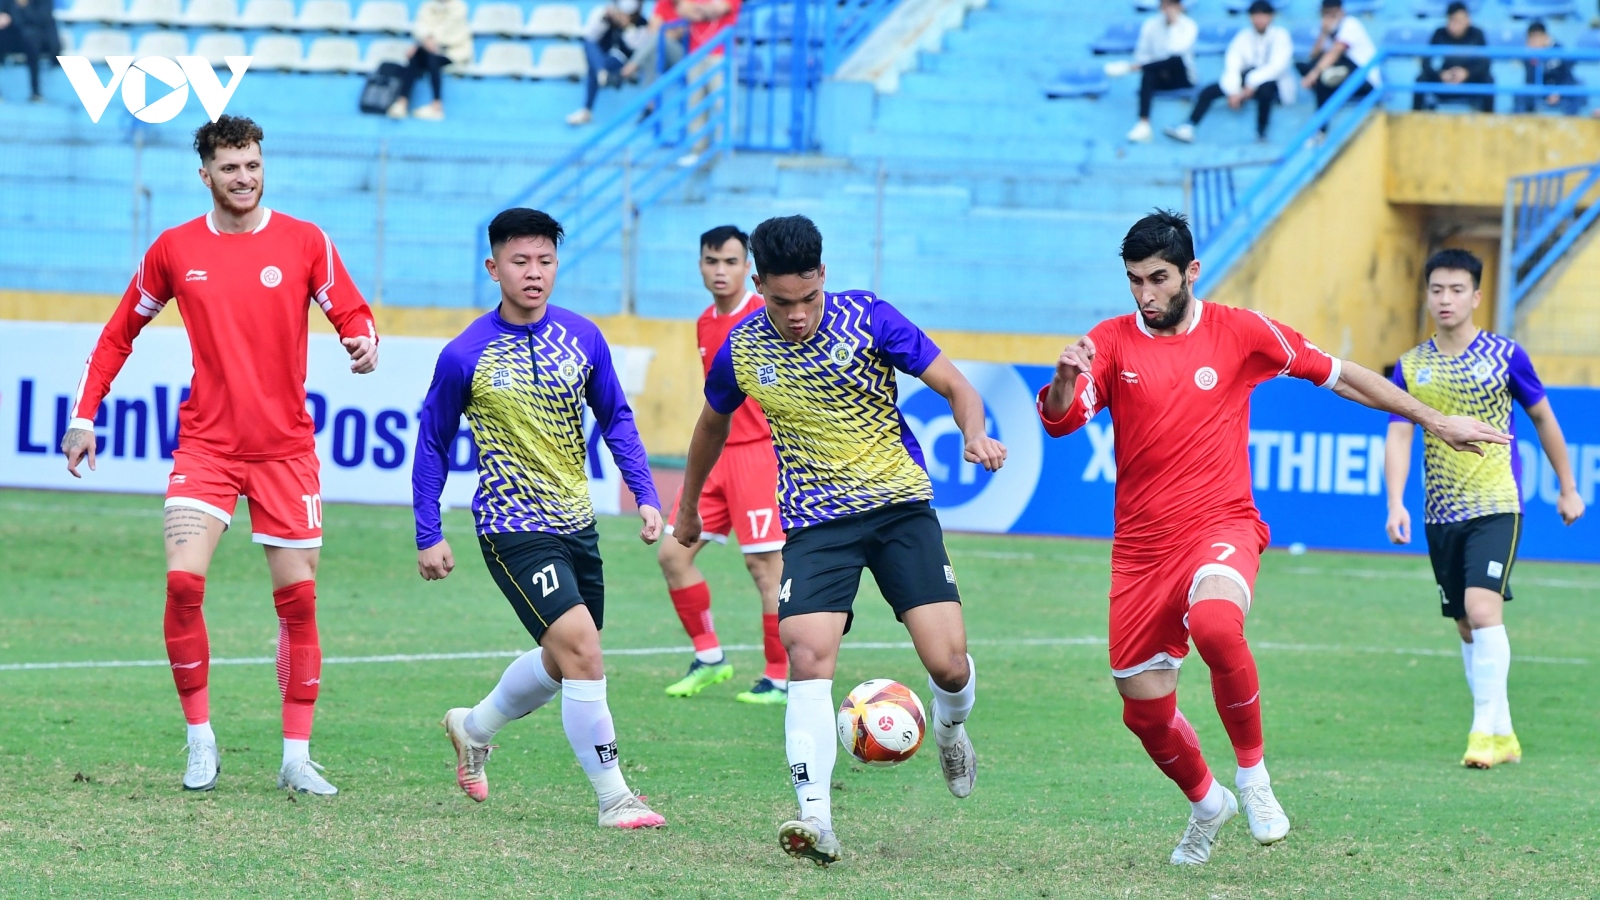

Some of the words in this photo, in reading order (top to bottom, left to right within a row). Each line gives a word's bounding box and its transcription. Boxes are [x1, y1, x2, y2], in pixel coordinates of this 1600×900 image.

[302, 493, 322, 530] 10
[746, 508, 773, 540] 17
[1210, 542, 1236, 562] 7
[531, 563, 560, 598] 27
[778, 578, 793, 608] 4
